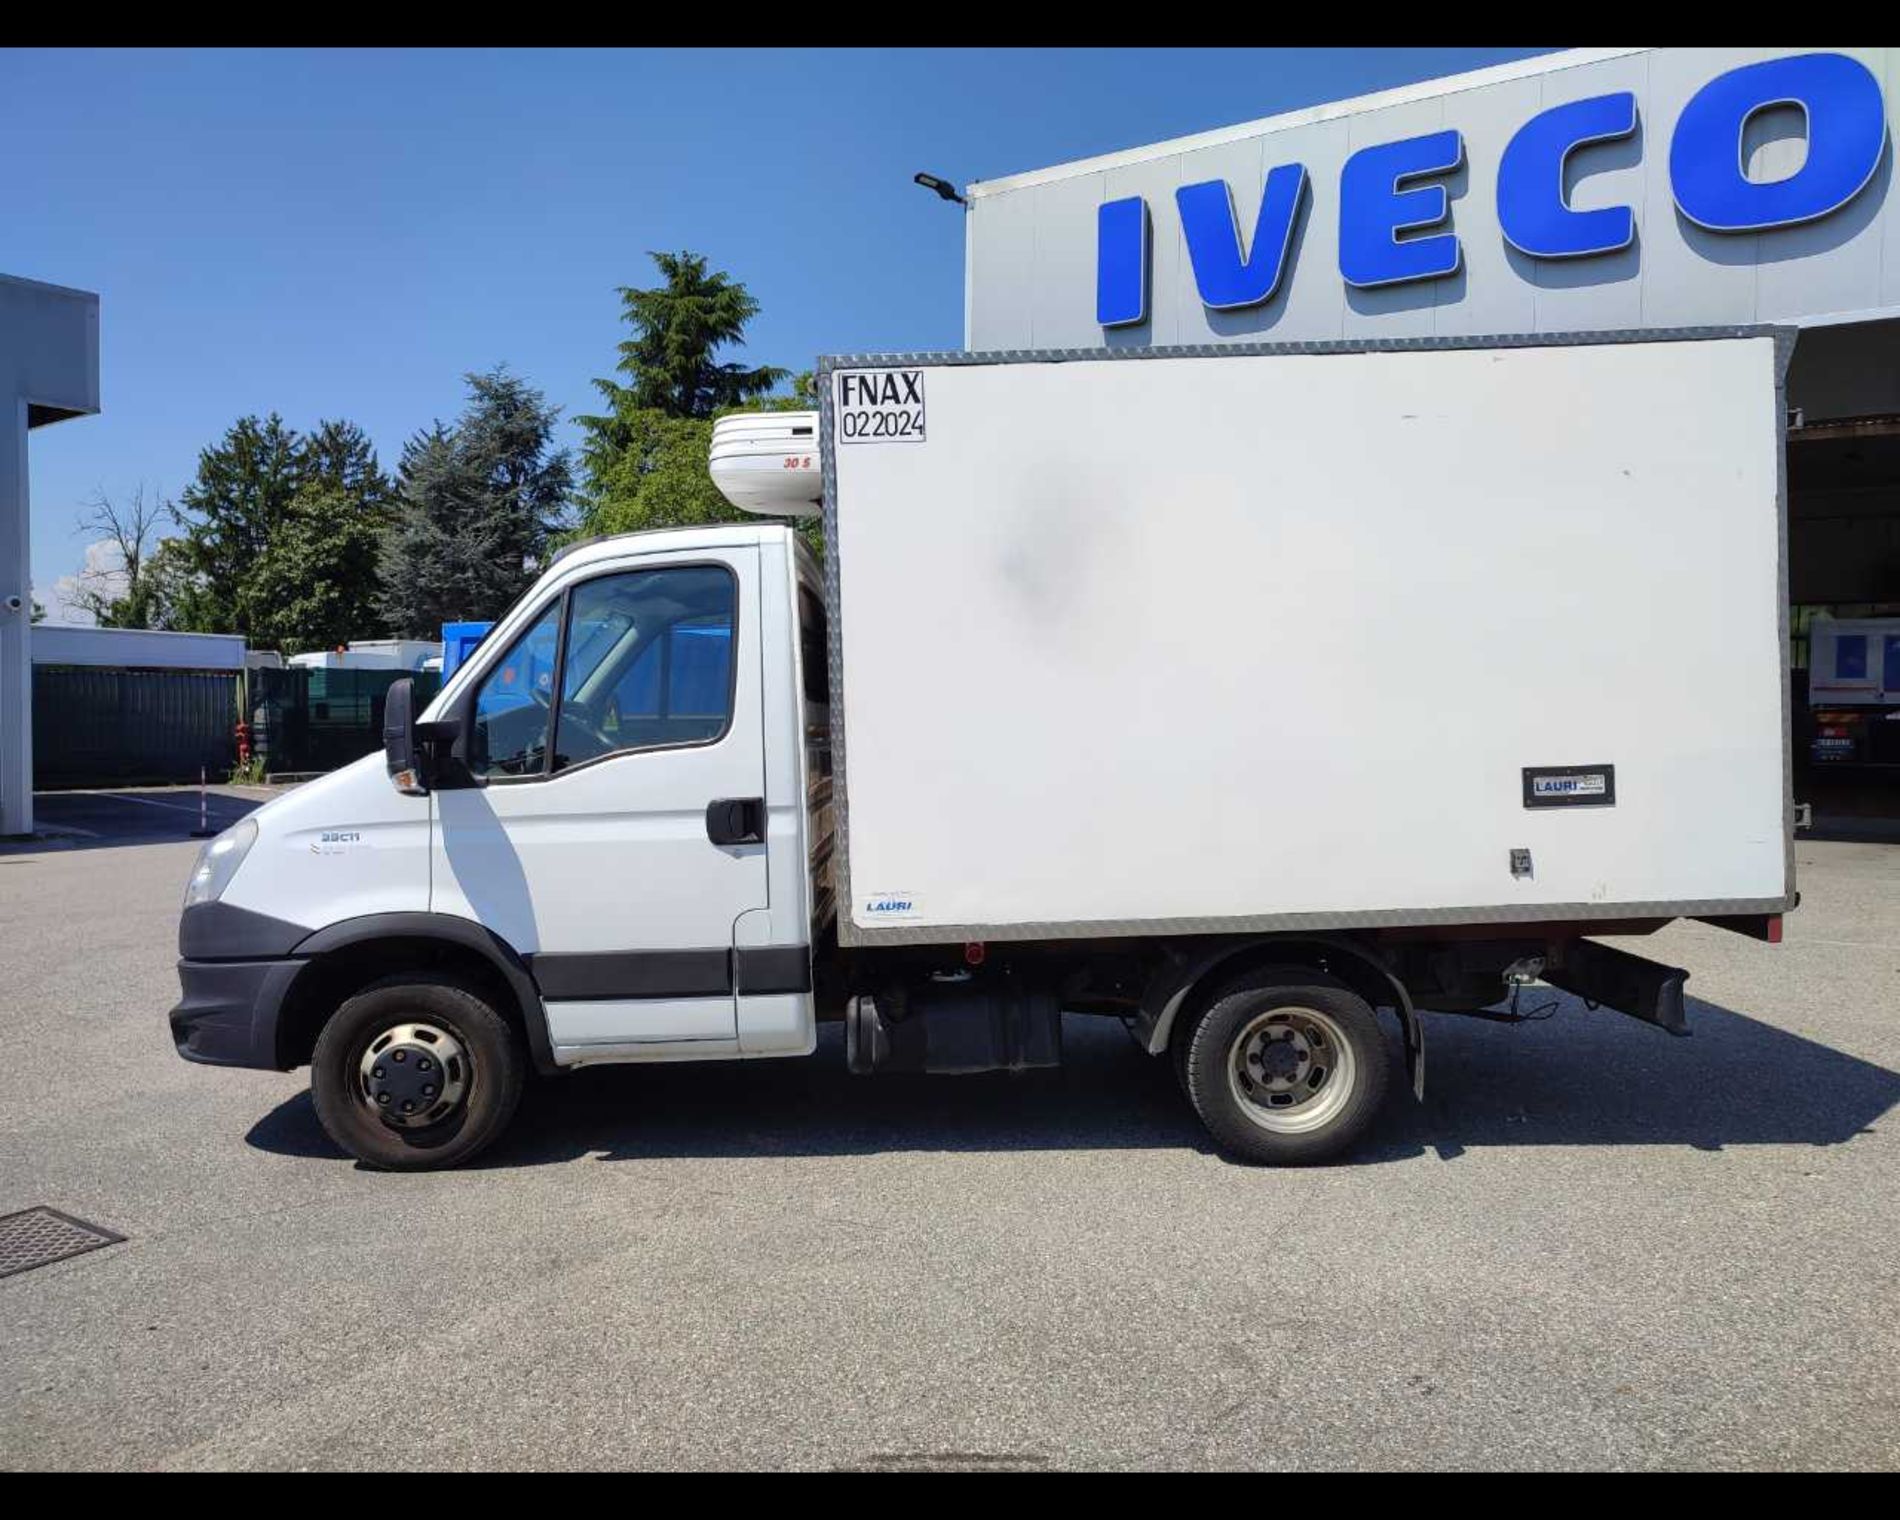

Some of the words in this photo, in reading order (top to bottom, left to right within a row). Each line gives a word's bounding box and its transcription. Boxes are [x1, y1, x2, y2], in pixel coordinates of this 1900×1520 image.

[1097, 52, 1887, 328] IVECO
[842, 373, 922, 405] FNAX
[843, 411, 924, 437] 022024
[784, 457, 799, 469] 30
[1535, 780, 1578, 792] LAURI
[866, 901, 913, 912] LAURI
